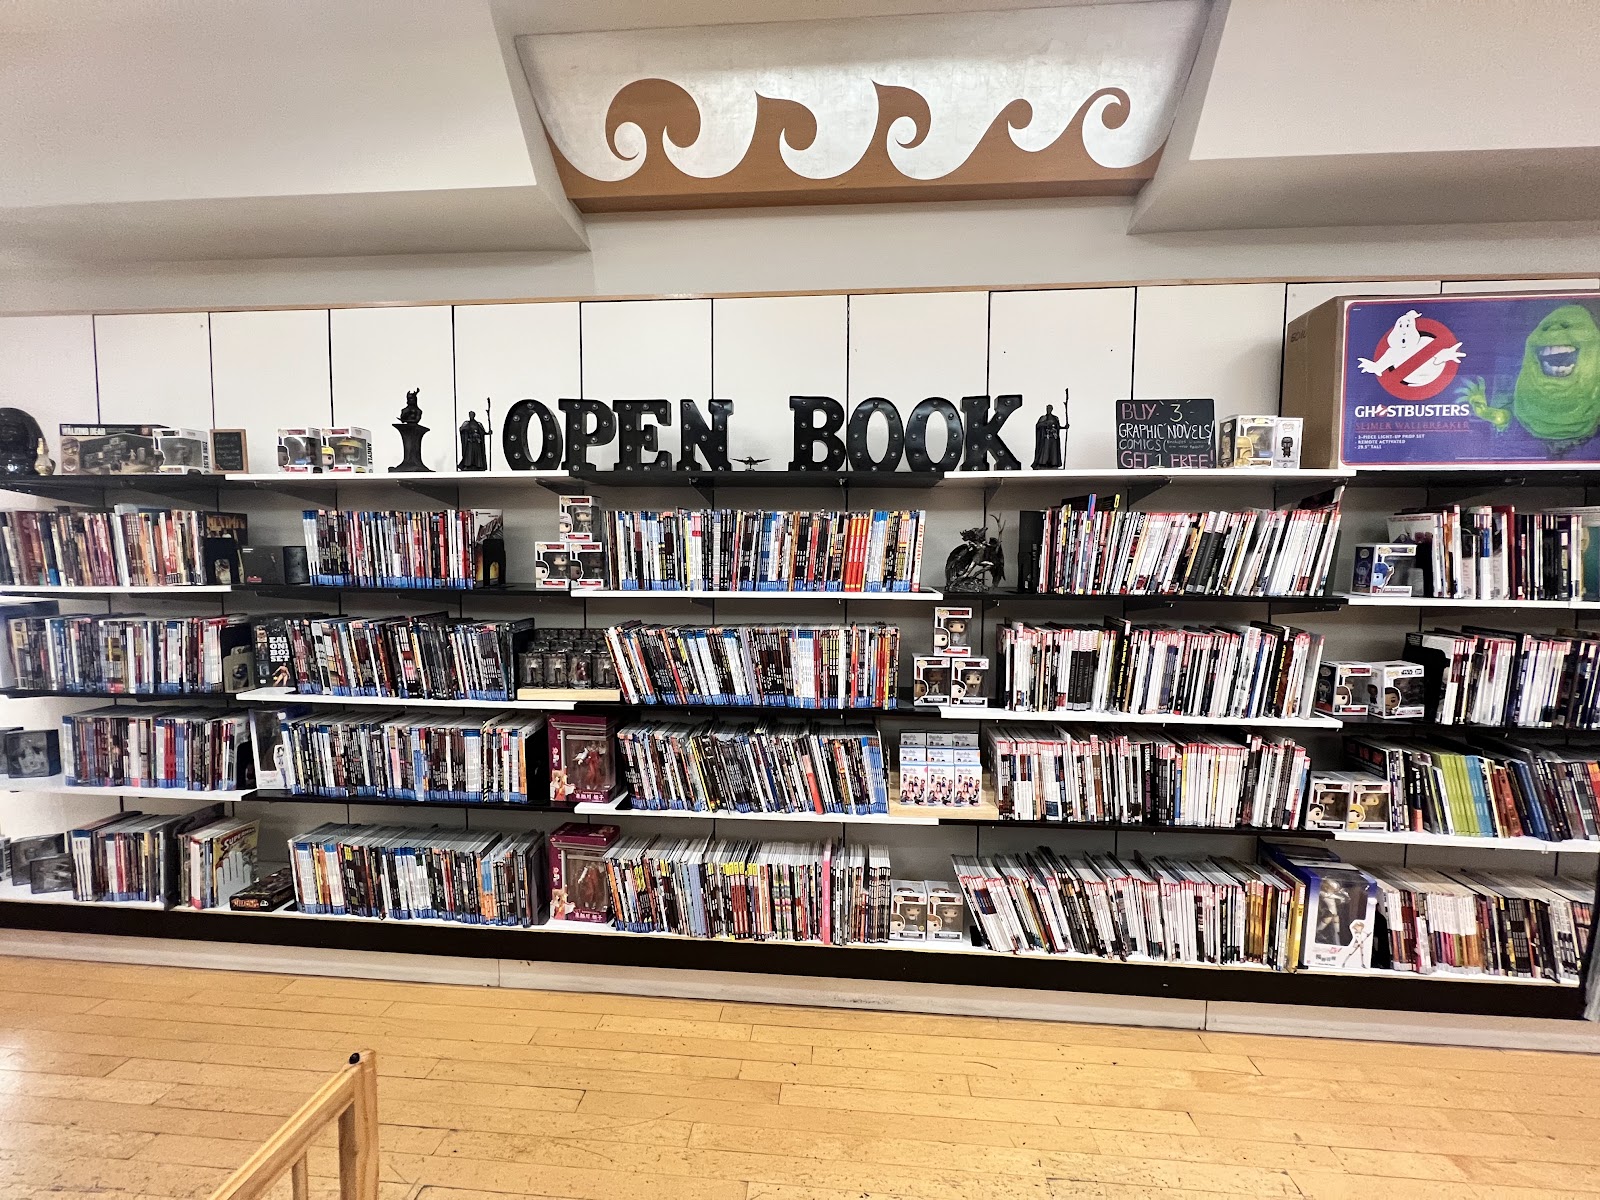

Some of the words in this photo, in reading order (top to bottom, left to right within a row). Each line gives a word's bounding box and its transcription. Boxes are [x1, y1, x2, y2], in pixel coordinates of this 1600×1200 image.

[1121, 402, 1156, 420] BUY
[1170, 403, 1183, 422] 3
[503, 398, 733, 472] OPEN
[789, 395, 1022, 472] BOOK
[1118, 423, 1165, 439] GRAPHIC
[1119, 439, 1161, 452] COMICS
[1120, 450, 1153, 469] GET
[1170, 449, 1214, 470] FREE!
[221, 827, 256, 851] SUPERMAN
